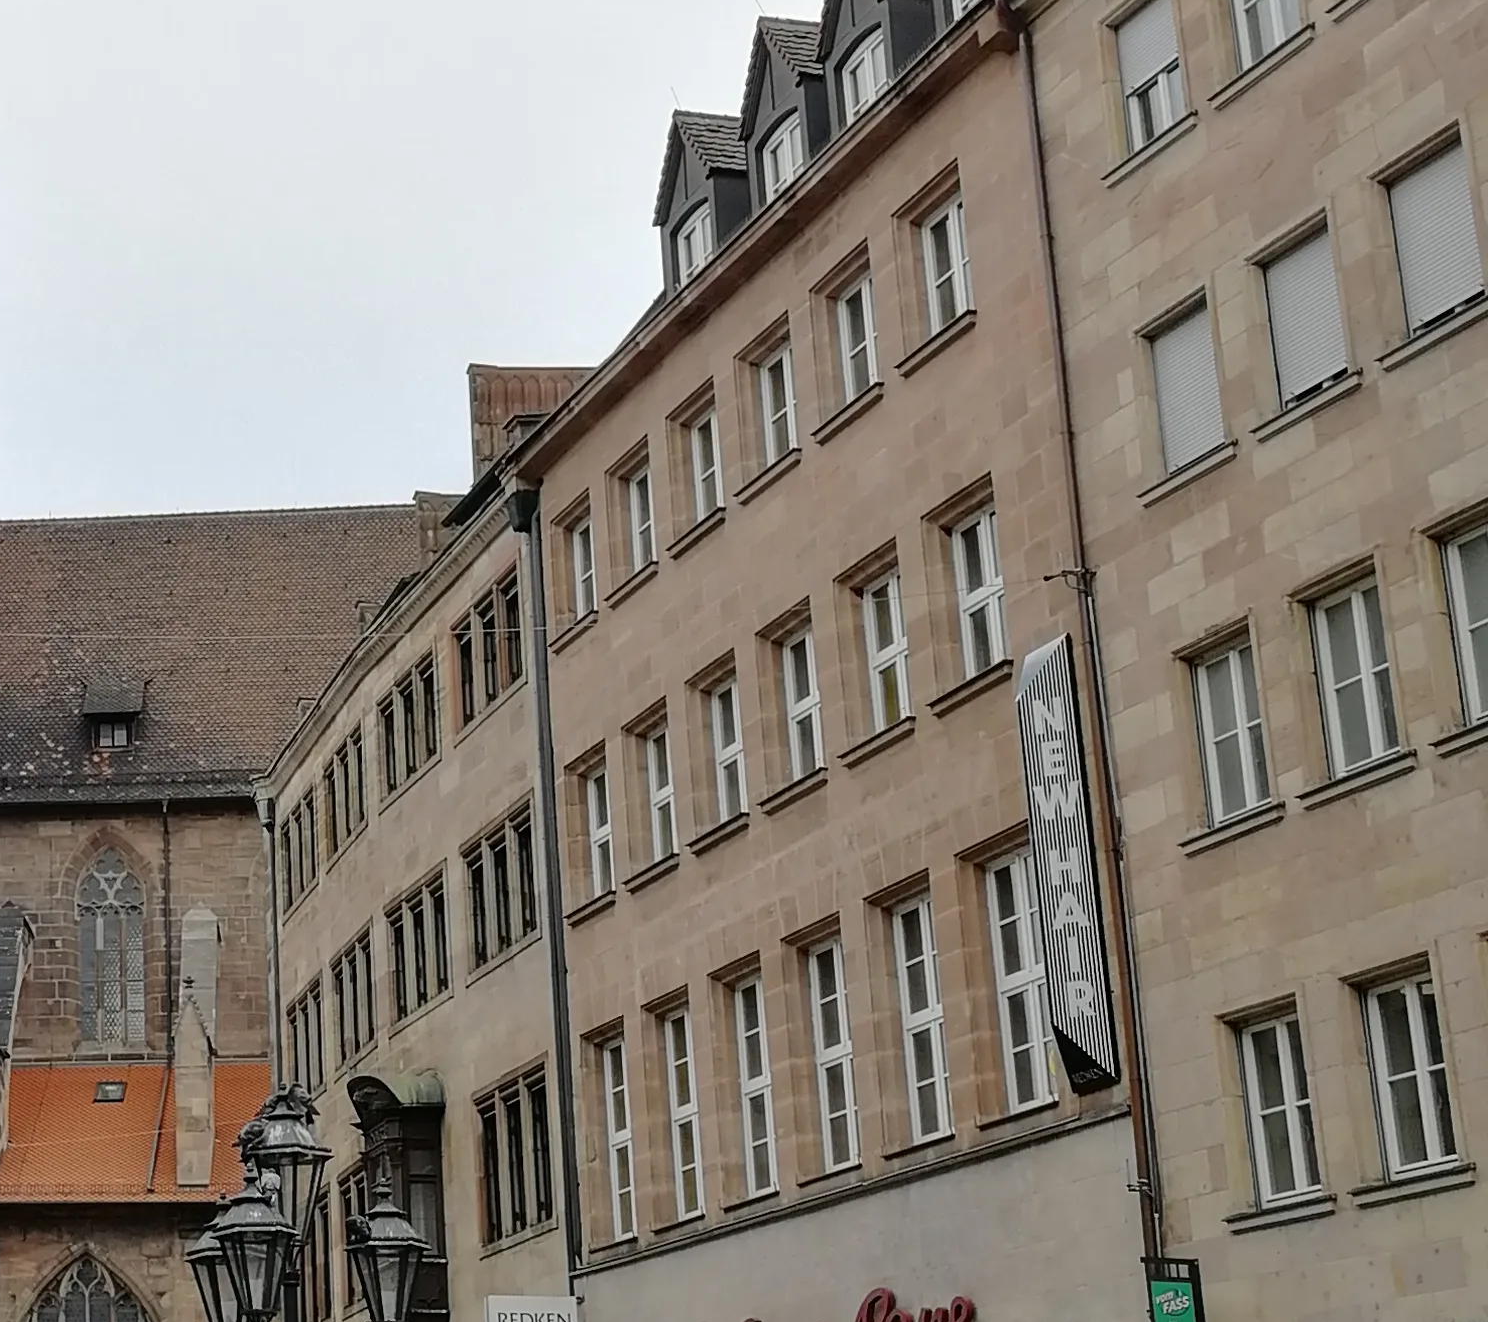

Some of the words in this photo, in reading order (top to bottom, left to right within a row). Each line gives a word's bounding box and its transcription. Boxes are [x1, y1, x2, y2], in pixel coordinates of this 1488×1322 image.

[1031, 695, 1081, 821] NEW
[1048, 846, 1097, 1019] HAIR
[1163, 1295, 1190, 1314] FASS
